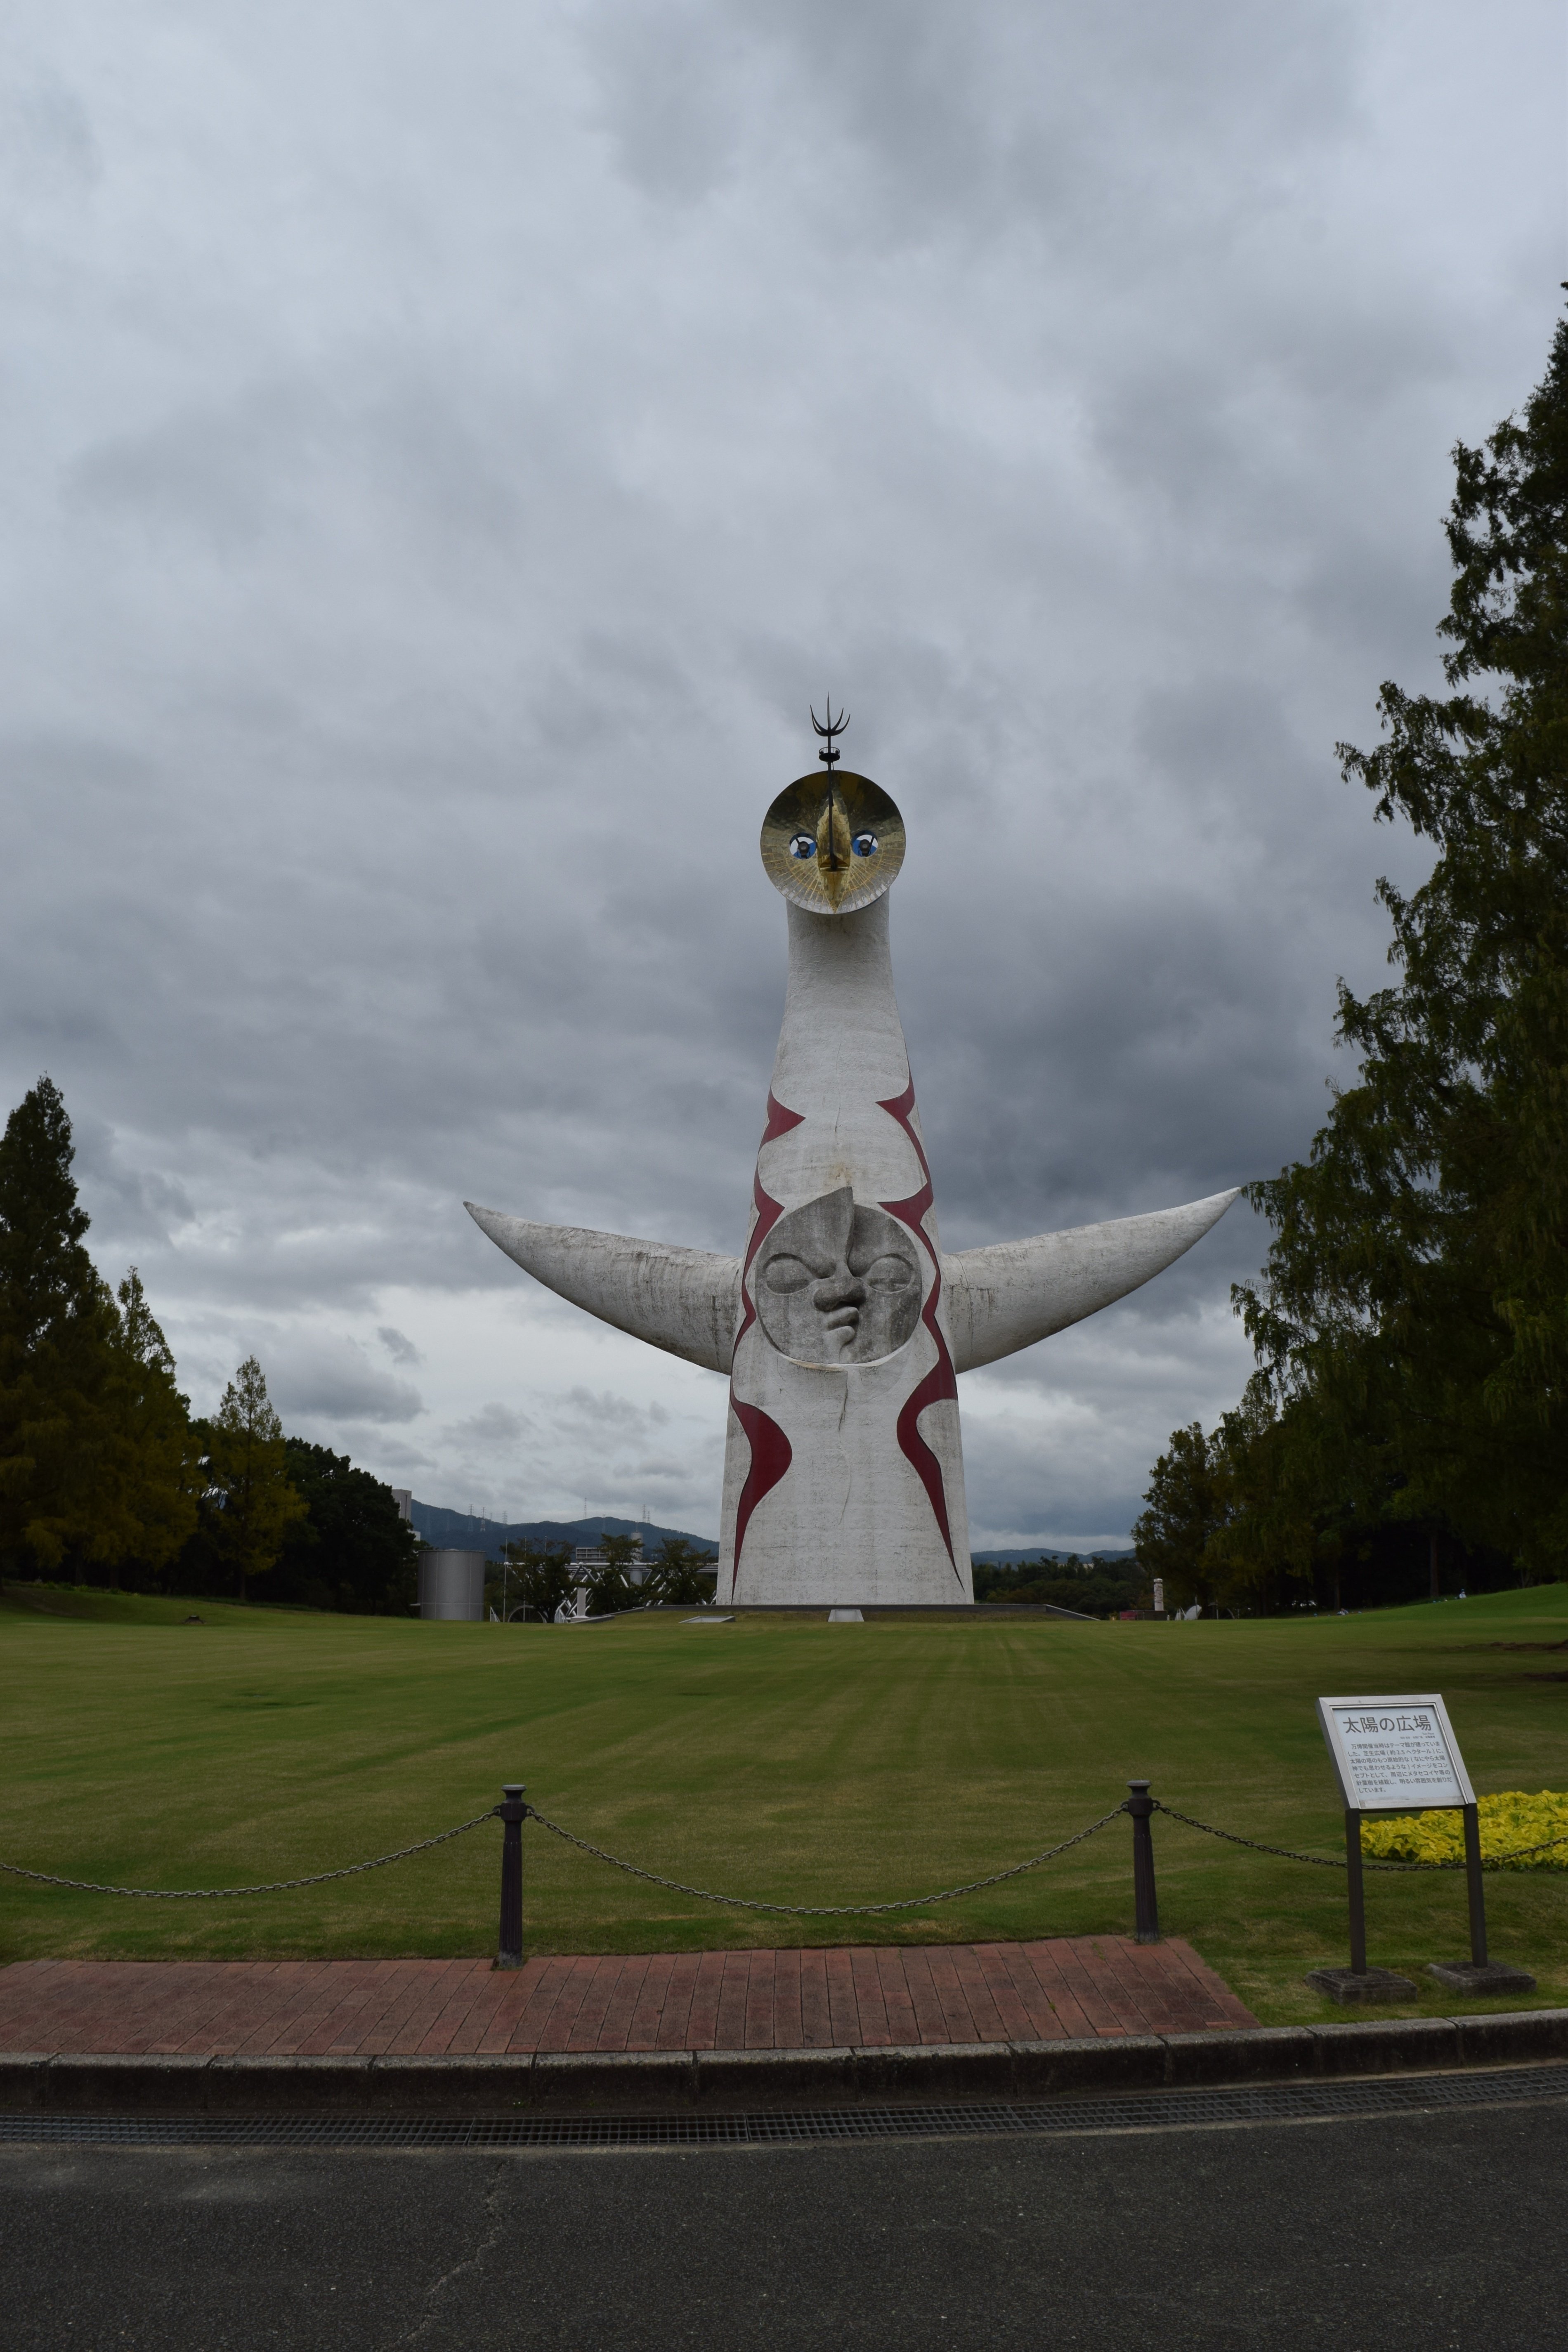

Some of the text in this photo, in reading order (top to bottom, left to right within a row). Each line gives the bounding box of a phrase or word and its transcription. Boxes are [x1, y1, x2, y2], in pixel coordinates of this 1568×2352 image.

[1343, 1715, 1431, 1733] 太陽の広場
